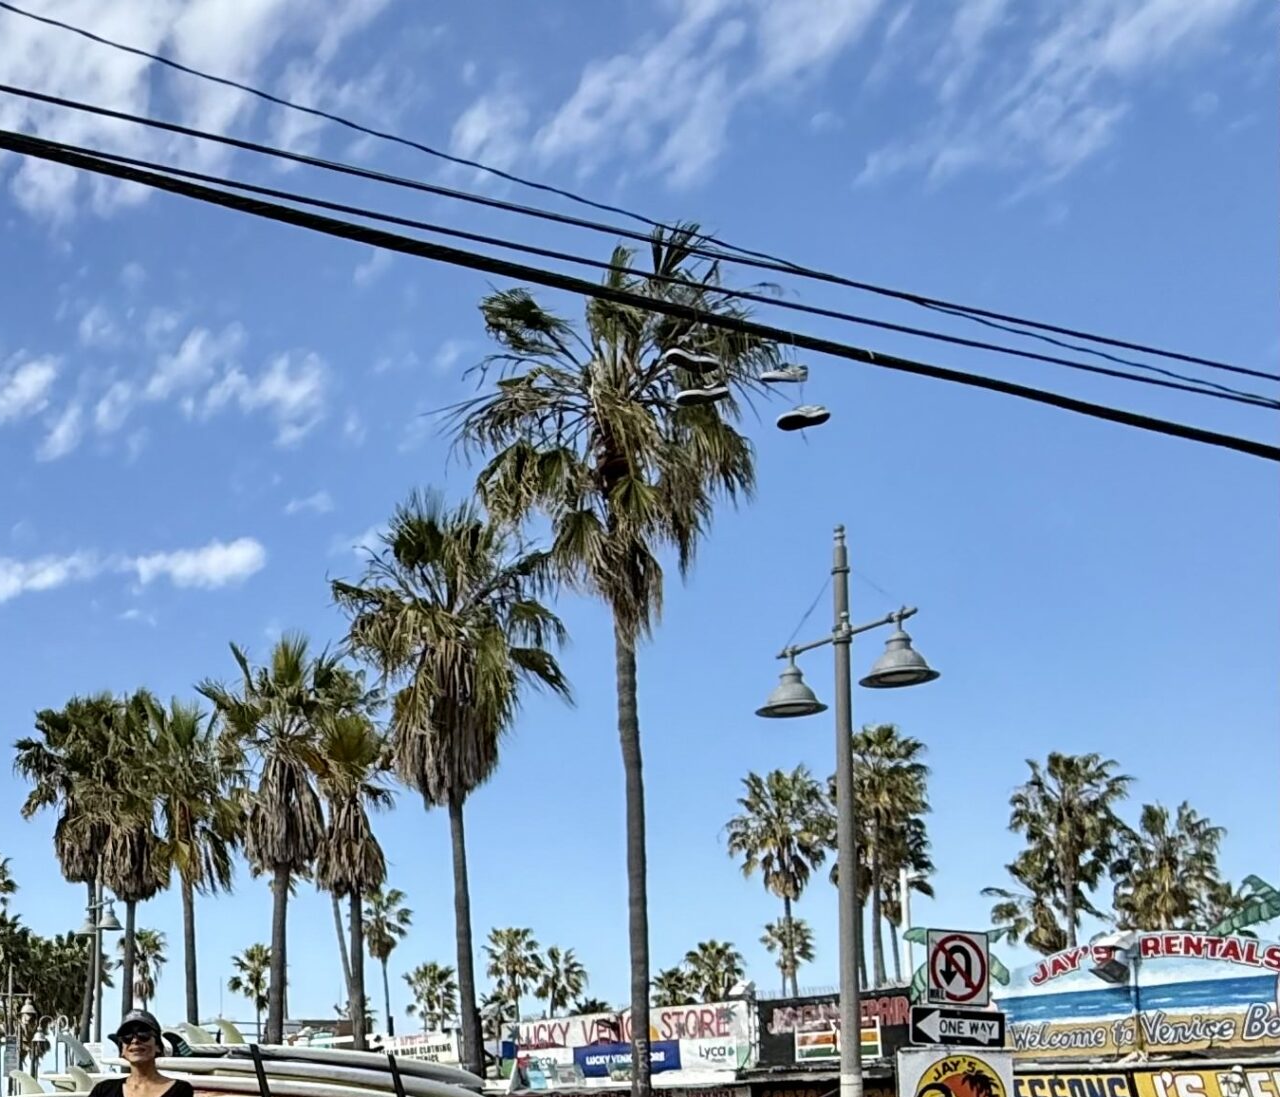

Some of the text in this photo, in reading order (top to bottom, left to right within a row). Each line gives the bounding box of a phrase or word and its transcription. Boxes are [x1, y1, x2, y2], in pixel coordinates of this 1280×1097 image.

[1032, 935, 1280, 984] JAY'S RENTALS
[581, 1015, 632, 1044] VENIC
[661, 1007, 731, 1039] STORE
[939, 1019, 995, 1036] ONE WAY
[1009, 1023, 1107, 1052] Welcome
[1111, 1019, 1135, 1047] to
[1140, 1011, 1236, 1045] Venice
[699, 1044, 727, 1059] Lyca
[933, 1058, 977, 1081] JAY'S
